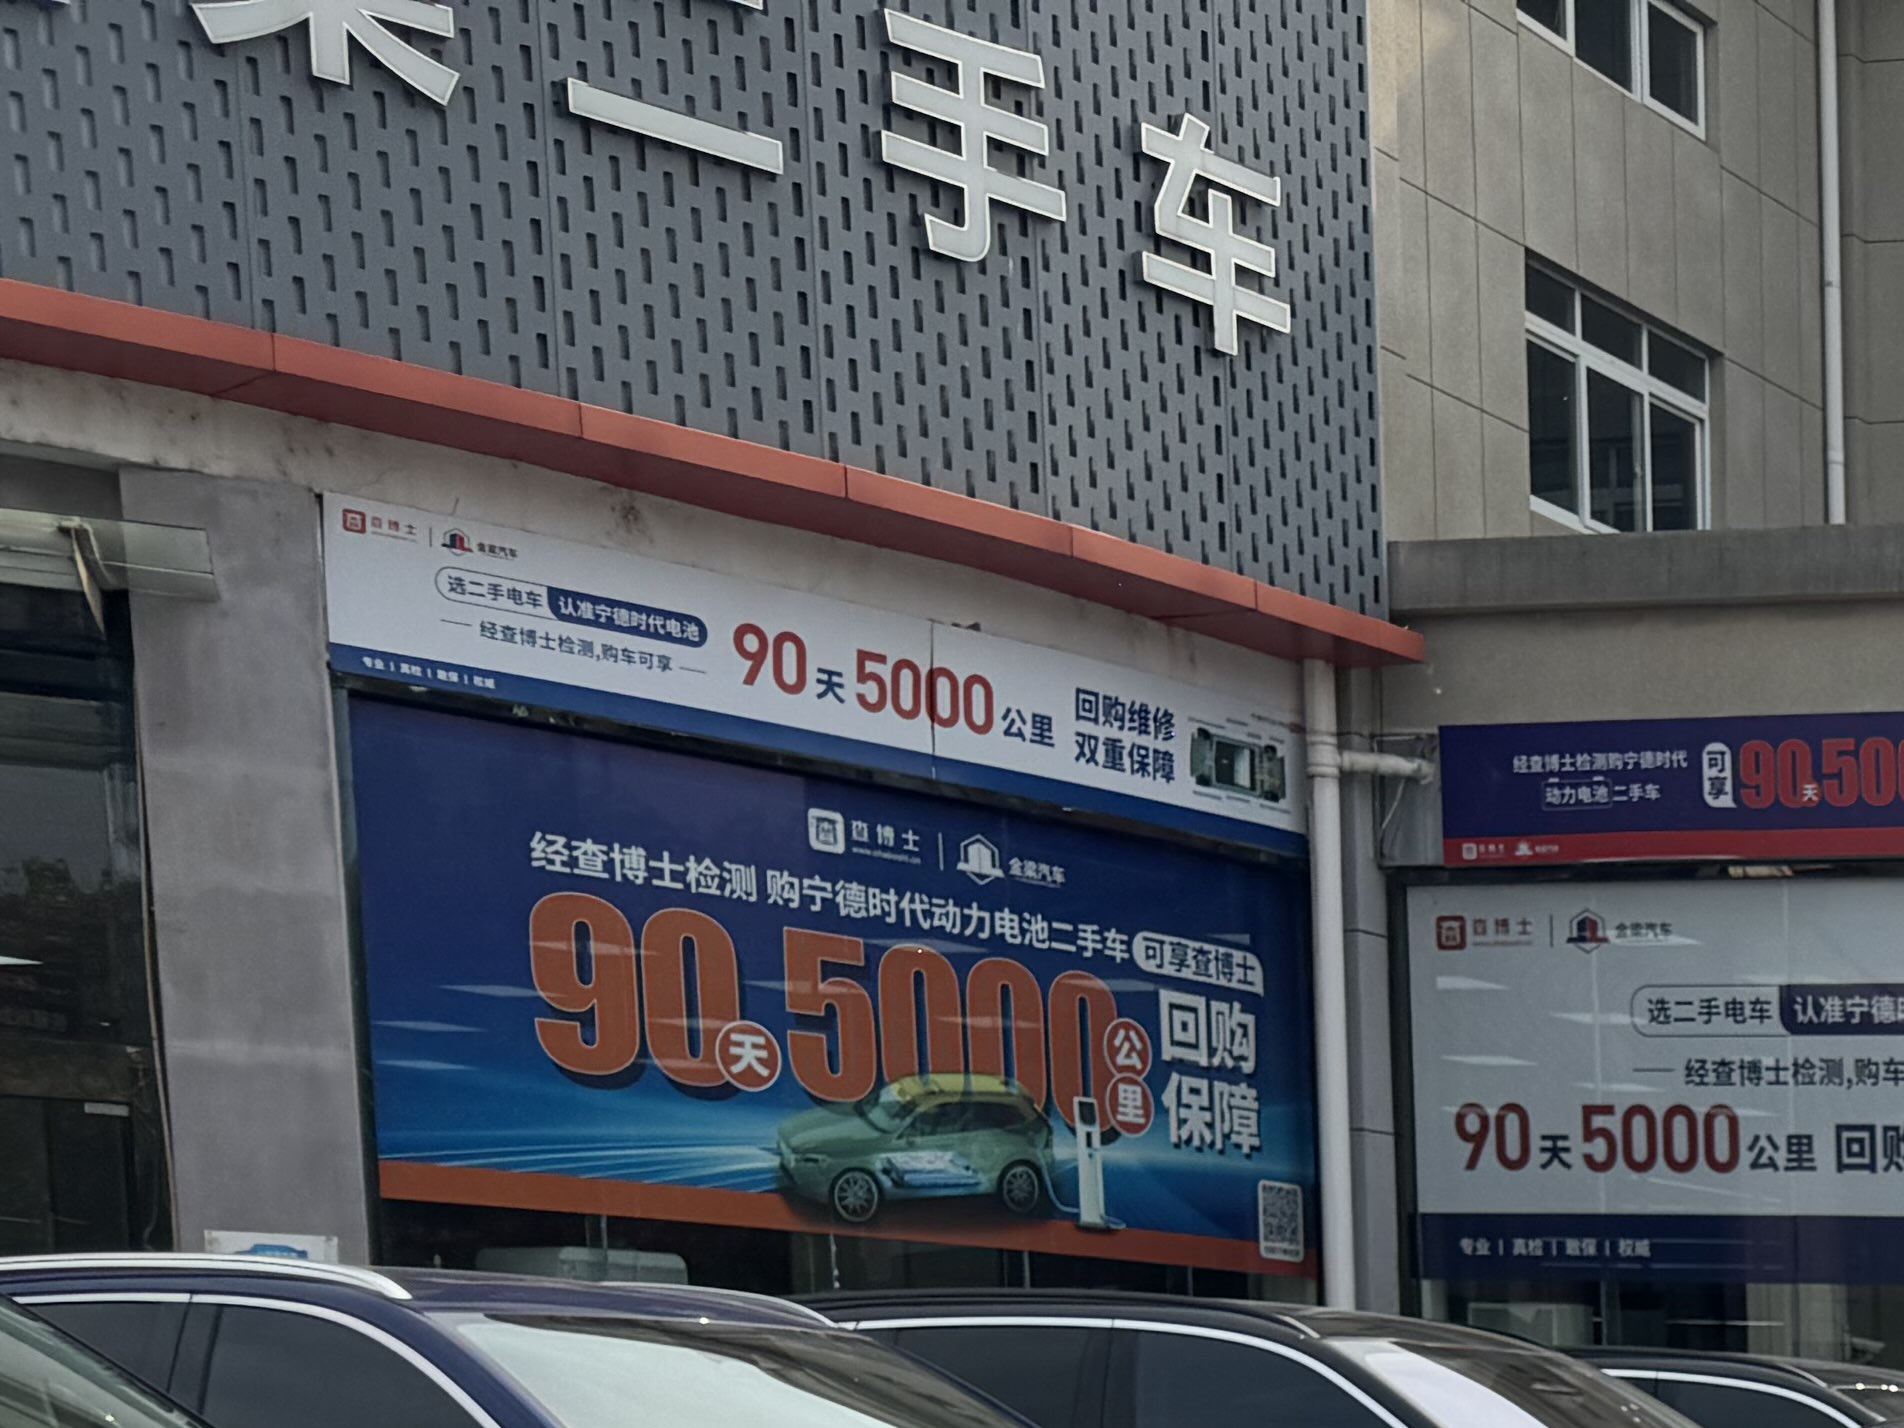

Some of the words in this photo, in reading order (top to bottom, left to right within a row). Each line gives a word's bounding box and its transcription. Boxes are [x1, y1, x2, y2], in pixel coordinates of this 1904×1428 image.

[193, 0, 1291, 356] 二手车
[447, 574, 544, 609] 选二手电车
[557, 595, 701, 643] 认准宁德时代电池
[1074, 687, 1177, 742] 回购维修
[1074, 729, 1177, 784] 双重保障
[1512, 750, 1689, 774] 经查博士检测购宁德时代
[529, 830, 758, 902] 经查博士检测
[766, 867, 1131, 964] 购宁德时代动力电池二手车
[1141, 934, 1258, 986] 可享查博士
[1158, 989, 1258, 1076] 回购
[1647, 998, 1773, 1025] 选二手电车
[1160, 1072, 1263, 1156] 保障
